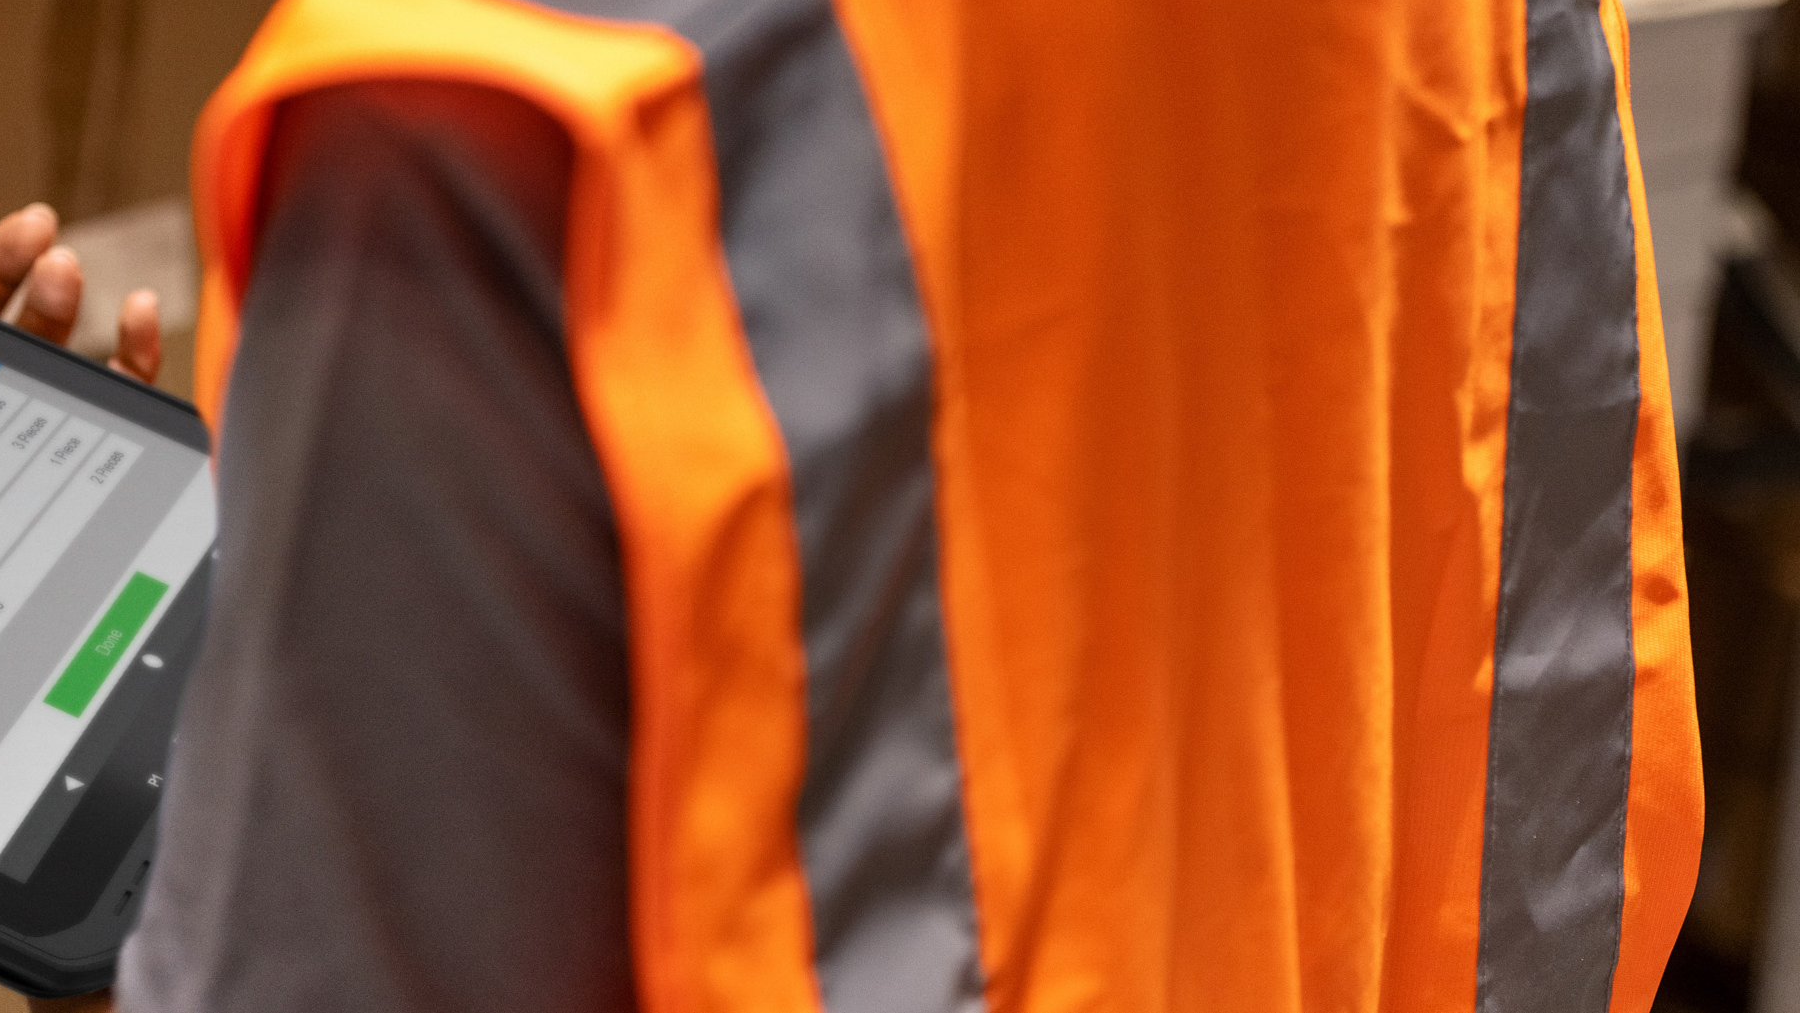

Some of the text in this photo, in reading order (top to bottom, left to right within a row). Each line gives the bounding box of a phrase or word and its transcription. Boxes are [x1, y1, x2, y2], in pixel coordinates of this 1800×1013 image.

[11, 416, 48, 451] 3 Pieces
[55, 437, 81, 462] Piece
[90, 450, 125, 485] 2 Pieces
[94, 629, 123, 657] Done
[148, 773, 163, 788] P1
